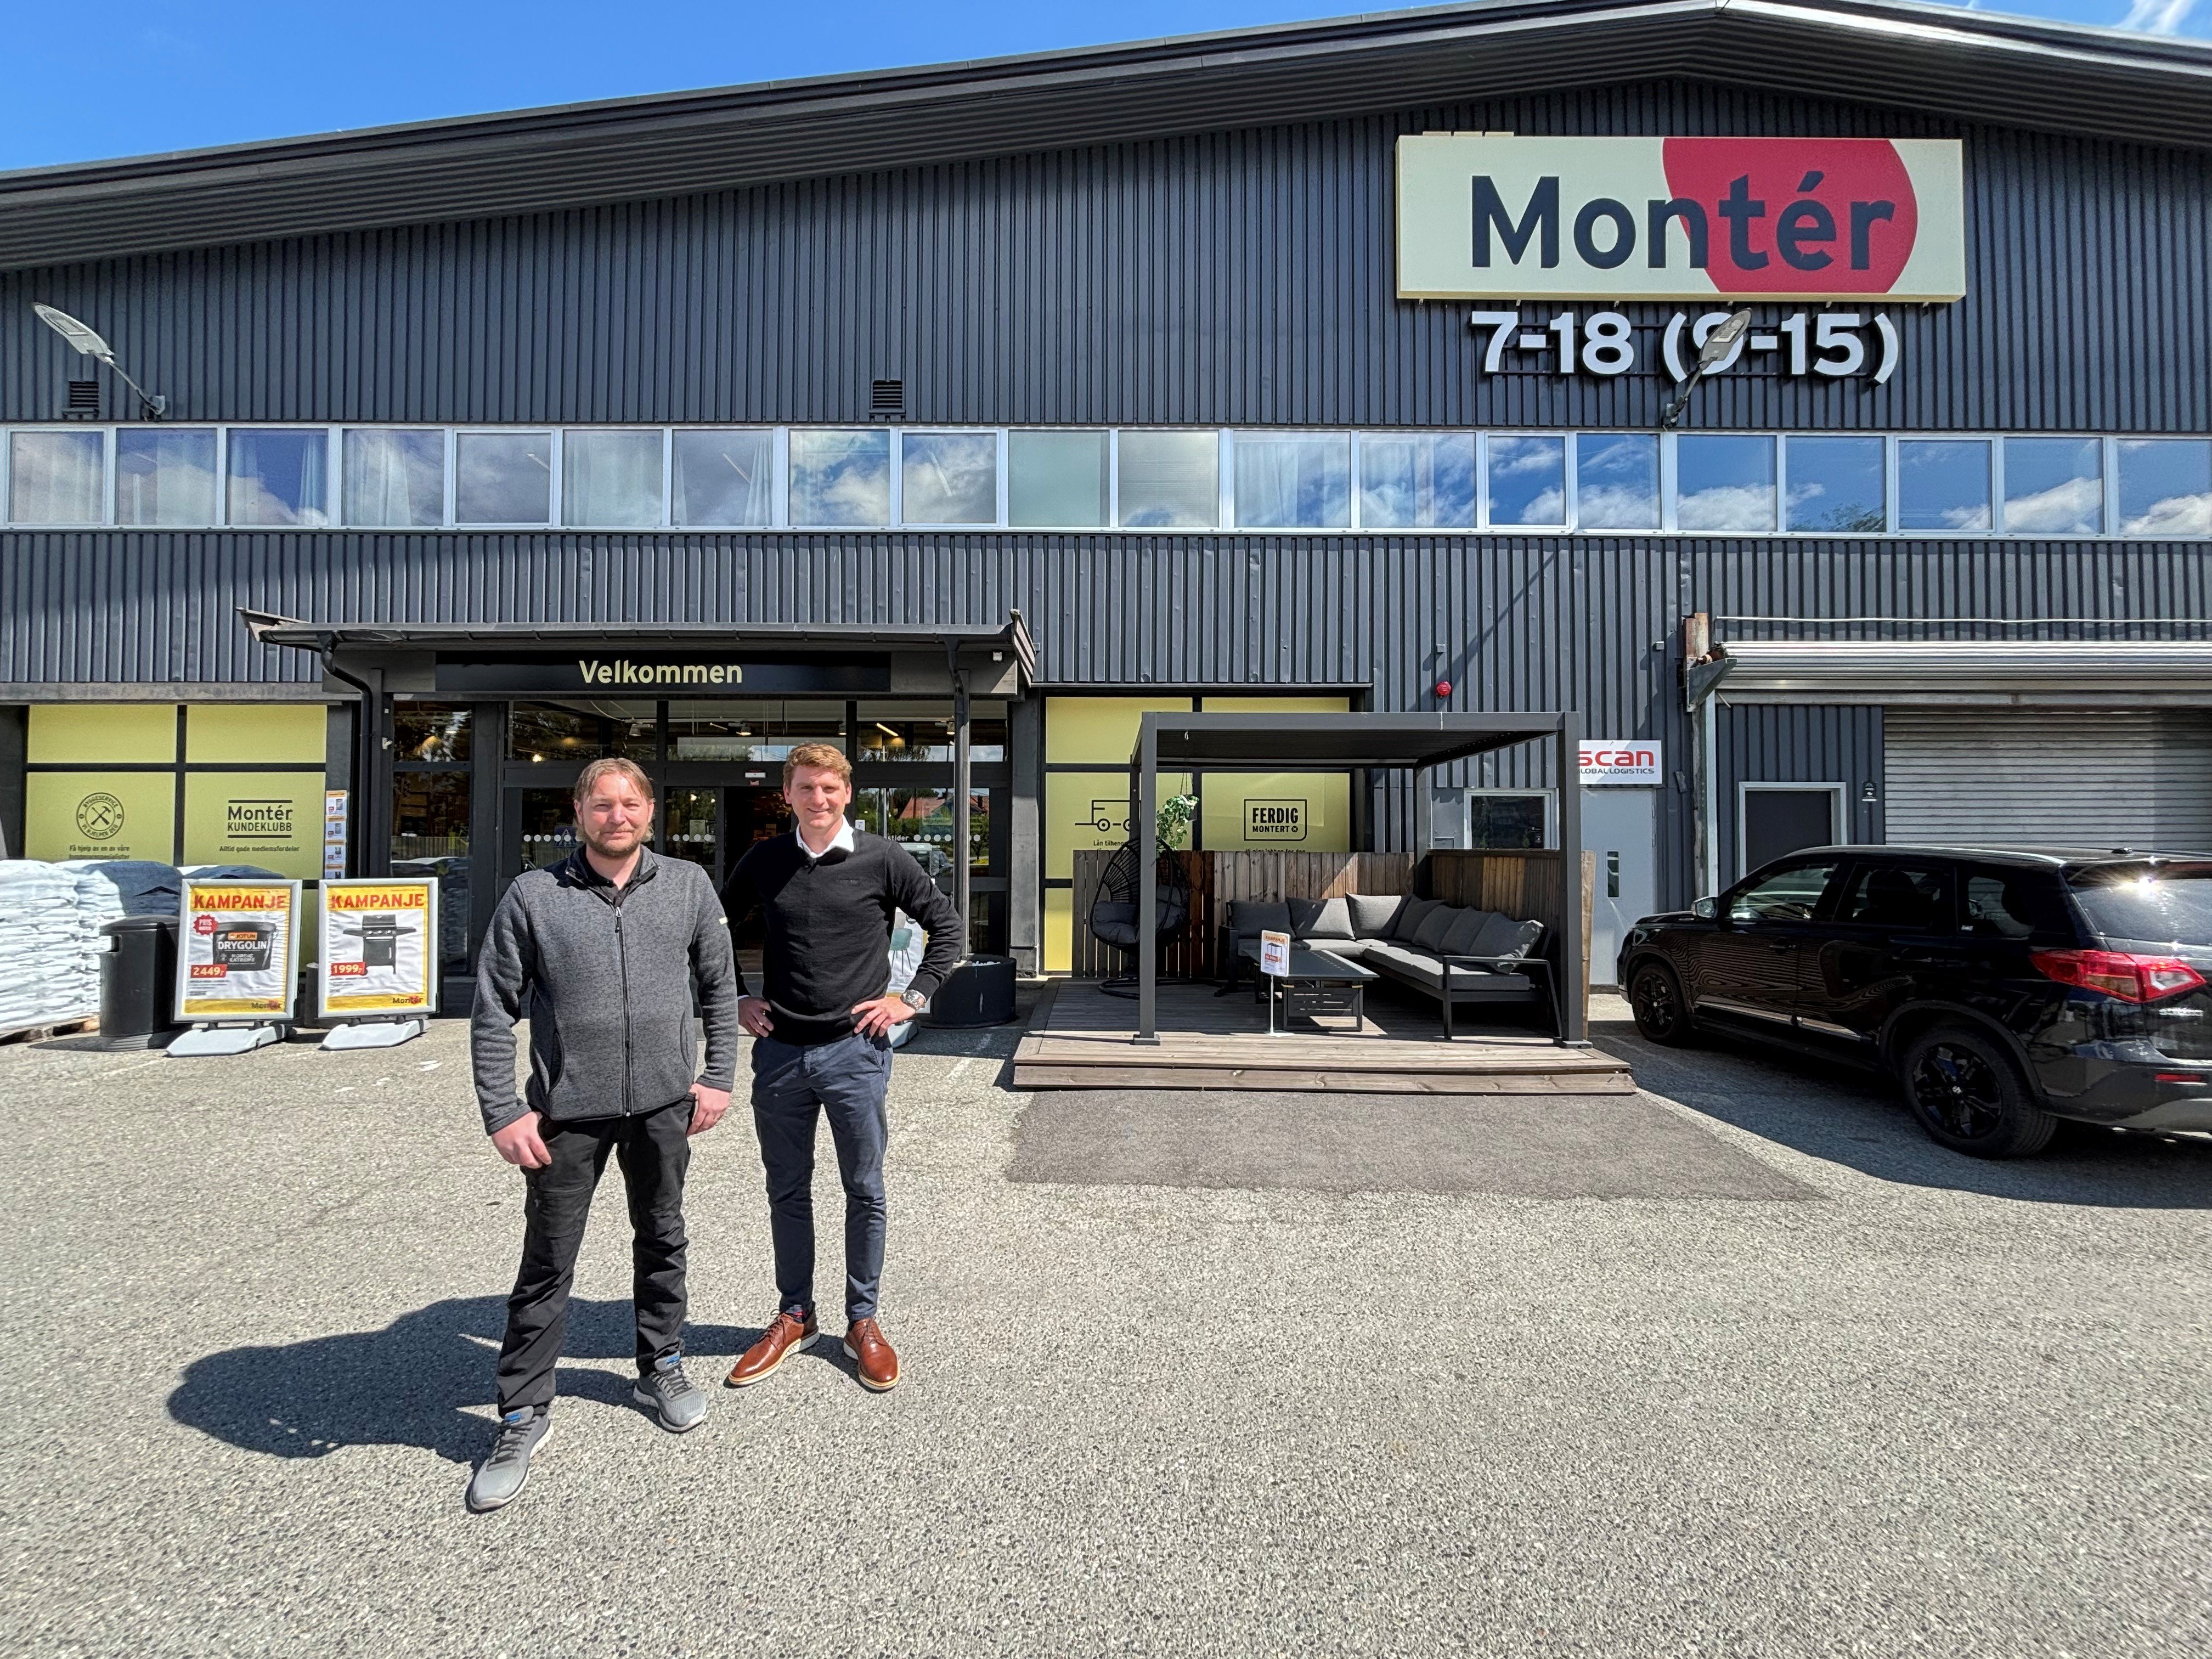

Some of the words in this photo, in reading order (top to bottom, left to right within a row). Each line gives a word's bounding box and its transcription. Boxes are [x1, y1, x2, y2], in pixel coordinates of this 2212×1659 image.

[1471, 170, 1895, 271] Montér
[1470, 311, 1635, 376] 7-18
[579, 659, 742, 684] Velkommen
[228, 805, 294, 821] Montér
[1252, 807, 1299, 824] FERDIG
[227, 822, 292, 832] KUNDEKLUBB
[194, 895, 287, 909] KAMPANJE
[331, 893, 425, 909] KAMPANJE
[217, 940, 268, 950] DRYGOLIN
